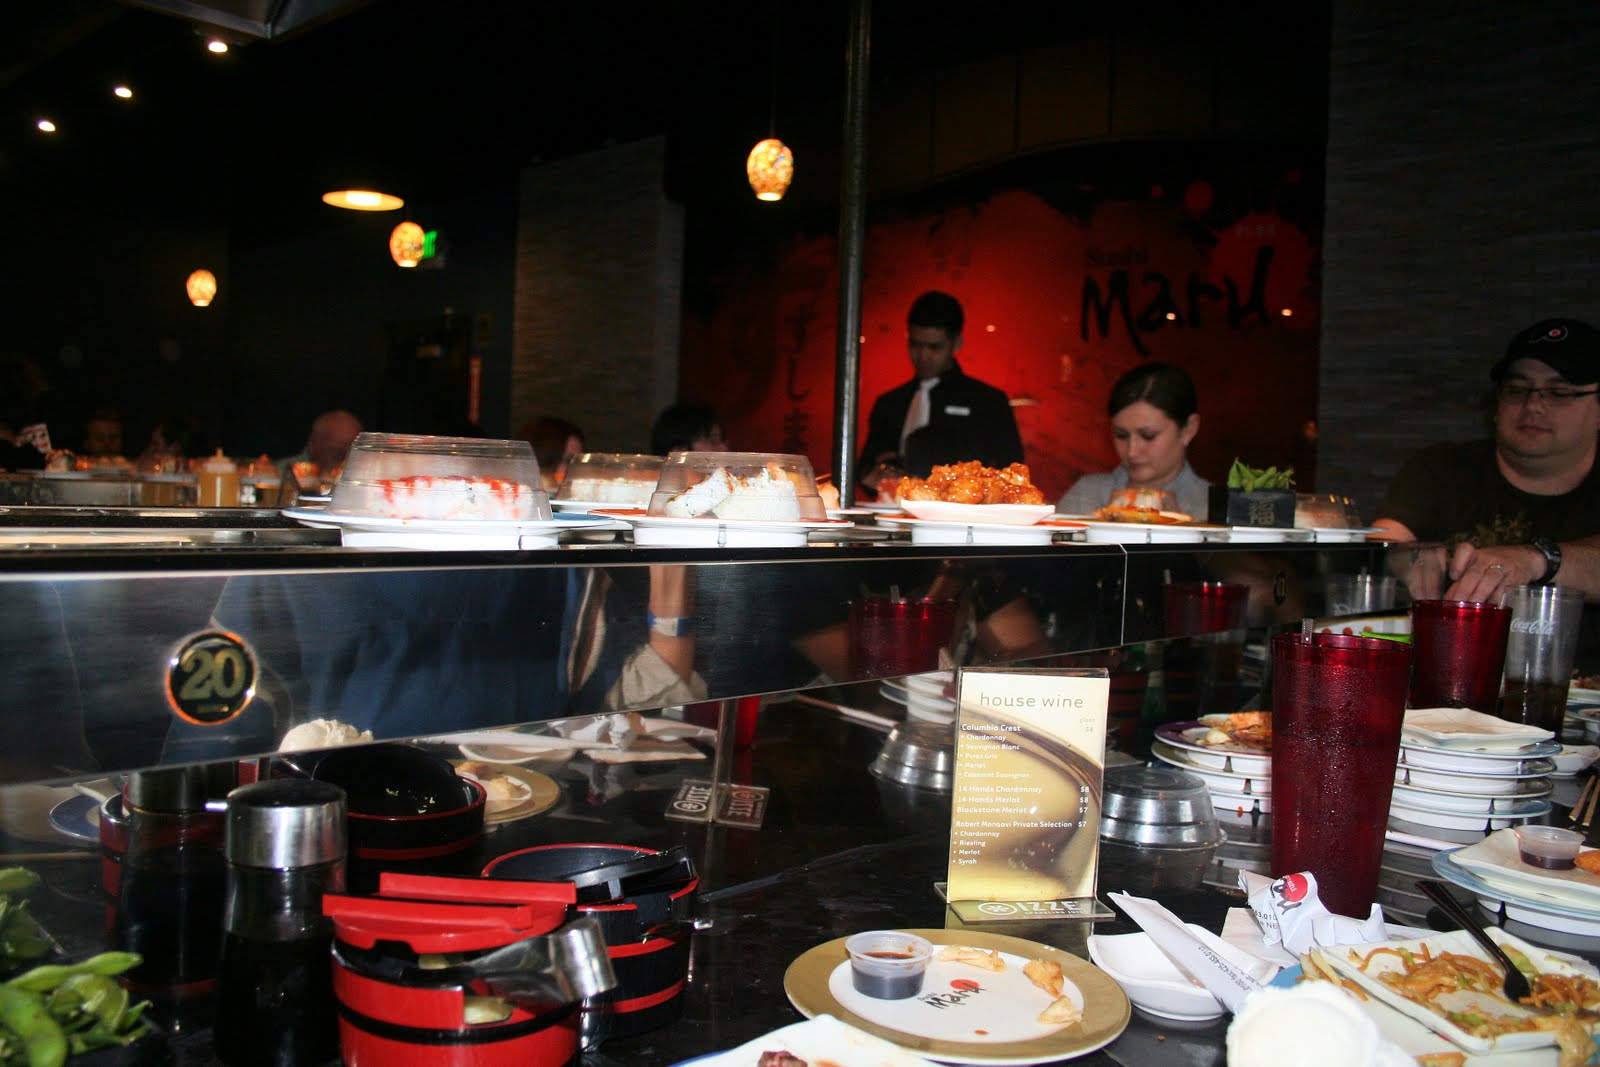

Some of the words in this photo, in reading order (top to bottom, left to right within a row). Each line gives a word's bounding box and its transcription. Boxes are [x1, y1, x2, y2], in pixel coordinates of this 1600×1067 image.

[1081, 245, 1275, 357] Maru
[180, 648, 247, 700] 20
[980, 692, 1036, 707] house
[1042, 693, 1084, 709] wine
[966, 734, 1007, 742] Chardonnay
[995, 785, 1042, 794] Chardonnay
[1080, 785, 1090, 793] $8
[1079, 796, 1089, 804] $8
[1001, 806, 1028, 814] Merlot
[1078, 806, 1089, 814] $7
[955, 820, 979, 828] Robert
[1013, 820, 1039, 828] Private
[959, 830, 1000, 838] Chardonnay
[959, 839, 986, 847] Riesling
[1016, 900, 1082, 912] IZZE
